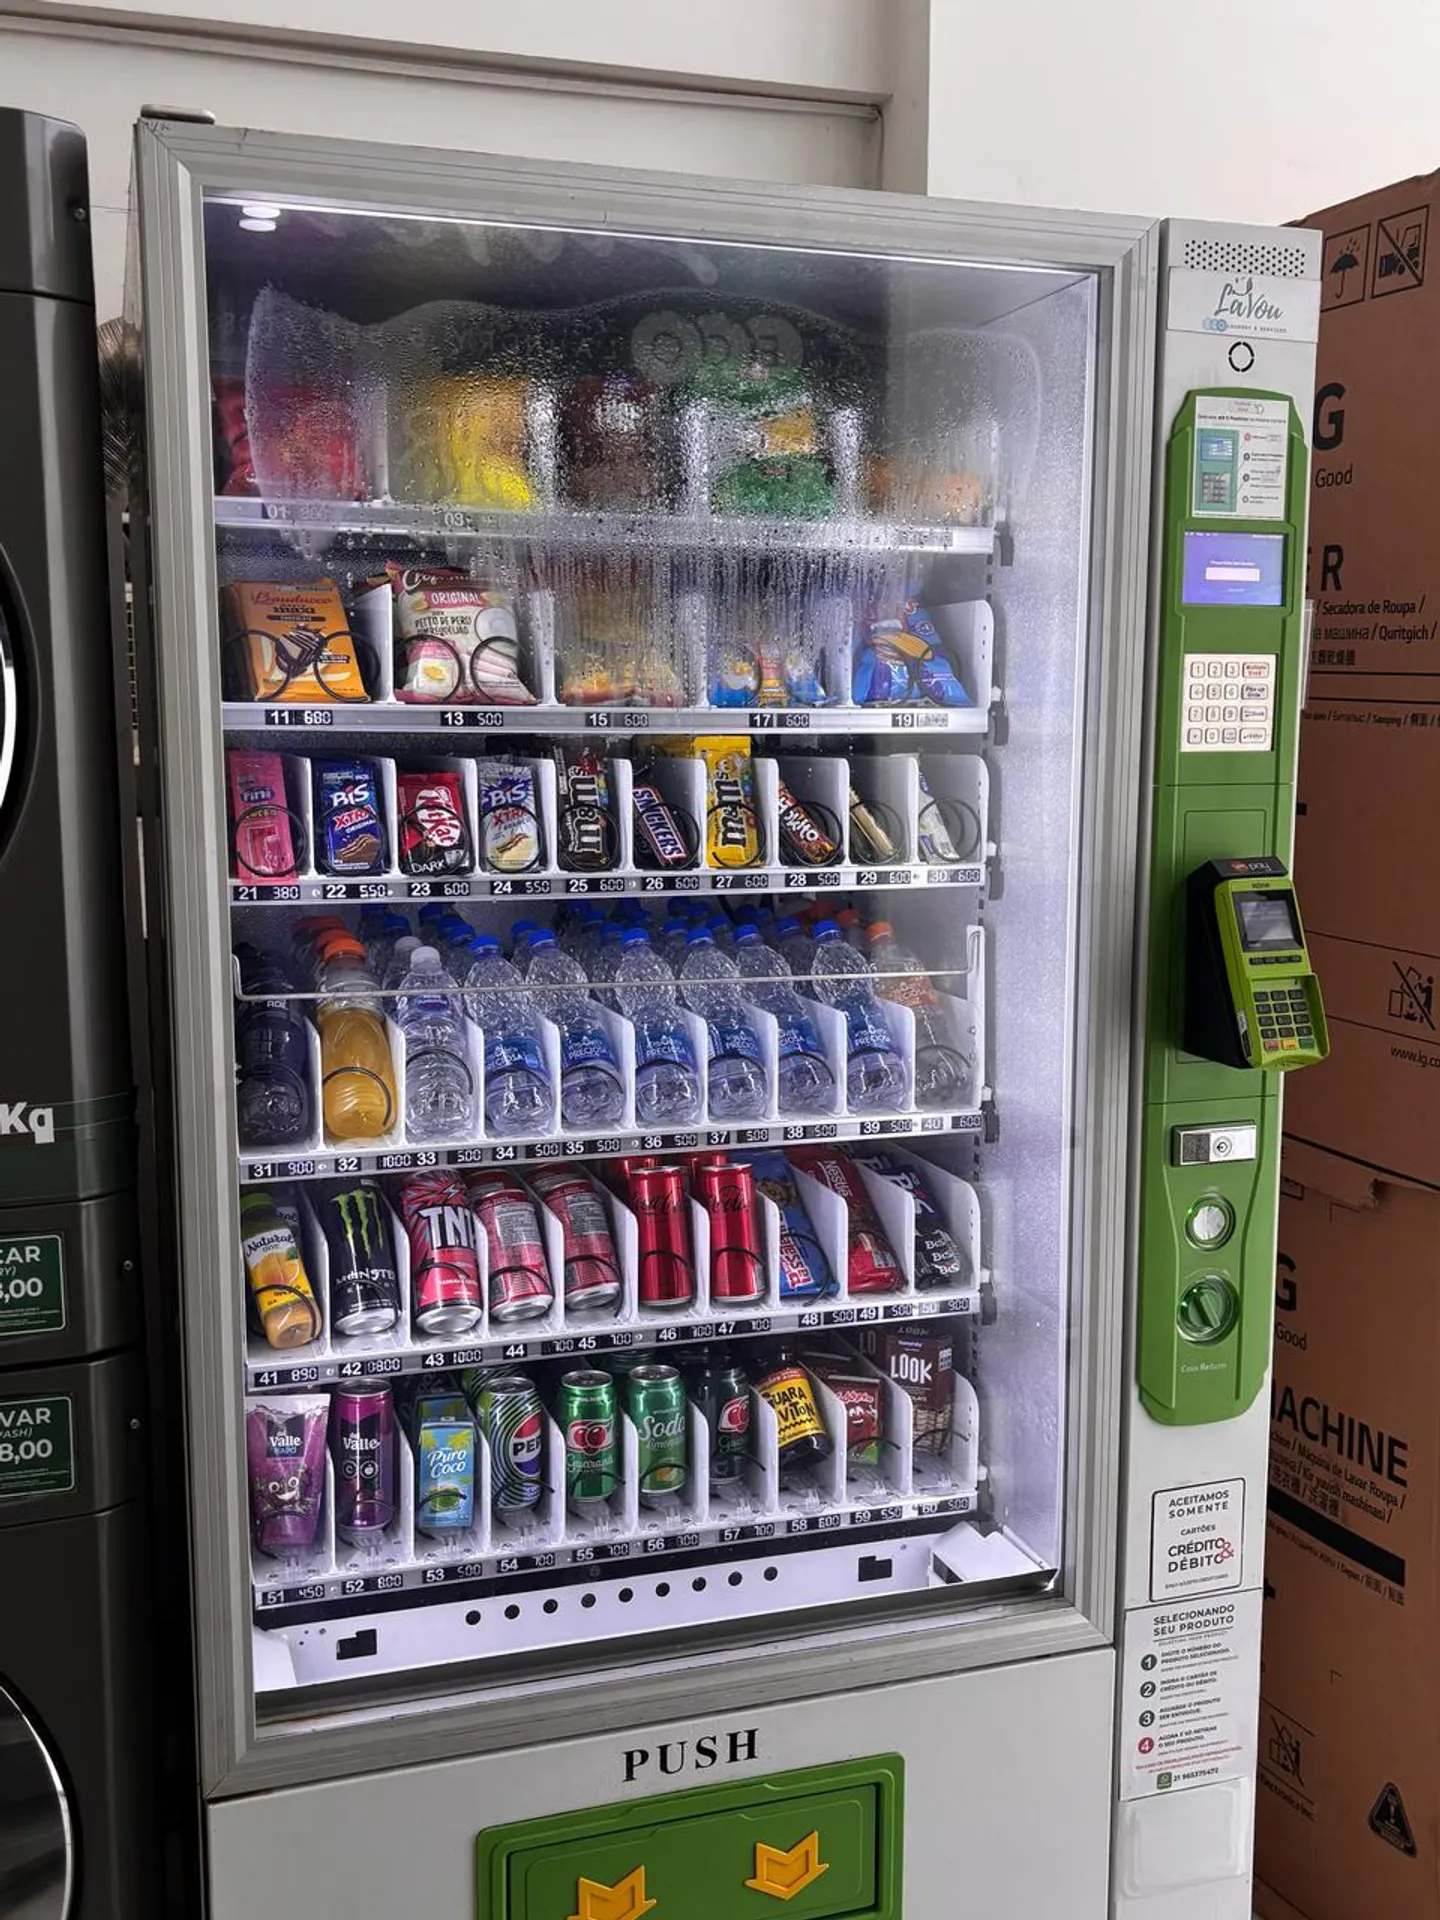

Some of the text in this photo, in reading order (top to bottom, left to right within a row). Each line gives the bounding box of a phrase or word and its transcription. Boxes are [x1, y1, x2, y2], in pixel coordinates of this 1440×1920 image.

[1315, 463, 1354, 488] Good
[431, 591, 481, 605] ORIGINAL
[1322, 600, 1417, 617] Secadora de Roupa
[1379, 625, 1429, 644] Quritgich
[271, 711, 290, 724] 11
[444, 712, 464, 725] 13
[589, 713, 608, 726] 15
[754, 714, 771, 726] 17
[895, 714, 912, 726] 19
[412, 859, 446, 874] DARK
[646, 878, 664, 890] 26
[716, 876, 733, 888] 27
[790, 874, 807, 886] 28
[861, 872, 877, 884] 29
[326, 885, 346, 898] 22
[411, 883, 431, 896] 23
[493, 881, 513, 894] 24
[570, 879, 588, 892] 25
[239, 887, 258, 900] 21
[787, 1126, 804, 1139] 38
[863, 1121, 880, 1134] 39
[645, 1136, 663, 1149] 36
[710, 1131, 728, 1144] 37
[496, 1146, 514, 1160] 34
[566, 1141, 584, 1154] 35
[338, 1158, 358, 1172] 32
[416, 1152, 436, 1165] 33
[254, 1163, 272, 1177] 31
[246, 1233, 295, 1258] Natural
[0, 1246, 41, 1265] AR
[0, 1277, 44, 1304] ,00
[801, 1312, 819, 1326] 48
[860, 1307, 876, 1320] 49
[659, 1327, 677, 1341] 46
[718, 1321, 736, 1335] 47
[578, 1336, 597, 1350] 45
[506, 1344, 525, 1357] 44
[425, 1353, 445, 1367] 43
[342, 1362, 362, 1376] 42
[890, 1353, 932, 1385] LOOK
[259, 1371, 278, 1385] 41
[0, 1426, 33, 1439] ASH)
[638, 1412, 685, 1441] Soda
[270, 1434, 302, 1448] Valle
[343, 1437, 379, 1451] Valle
[427, 1448, 467, 1466] Puro
[431, 1461, 467, 1479] Coco
[1168, 1489, 1230, 1508] ACEITAMOS
[855, 1511, 871, 1523] 59
[1168, 1501, 1229, 1519] SOMENTE
[791, 1519, 808, 1532] 58
[1180, 1524, 1216, 1536] CARTÕES
[724, 1528, 740, 1542] 57
[647, 1539, 665, 1552] 56
[1168, 1537, 1225, 1557] CRÉDITO
[576, 1548, 594, 1562] 55
[500, 1559, 518, 1572] 54
[1168, 1552, 1224, 1573] DÉBITO
[426, 1568, 444, 1582] 53
[346, 1579, 364, 1593] 52
[267, 1591, 284, 1605] 51
[1153, 1604, 1235, 1626] SELECIONANDO
[1153, 1615, 1235, 1637] SEU PRODUTO
[621, 1728, 759, 1783] PUSH
